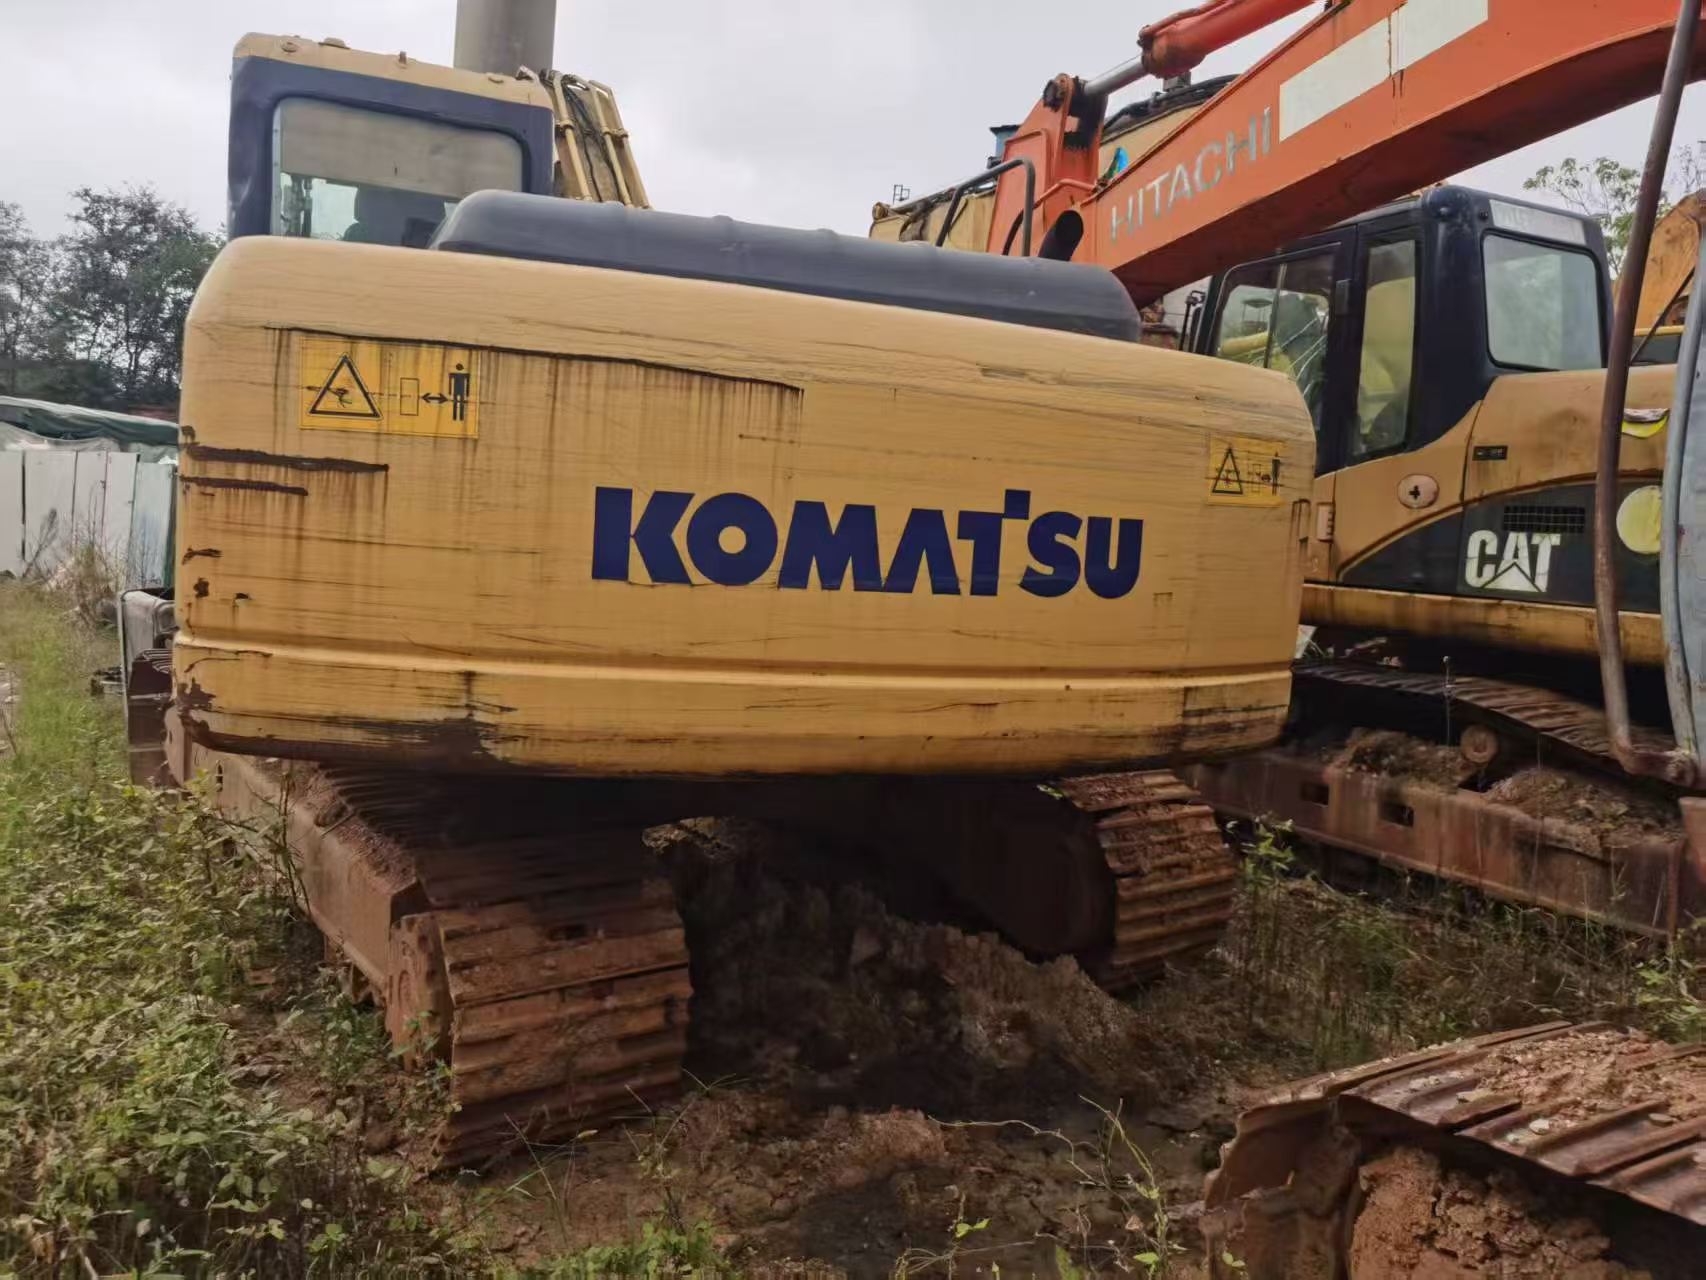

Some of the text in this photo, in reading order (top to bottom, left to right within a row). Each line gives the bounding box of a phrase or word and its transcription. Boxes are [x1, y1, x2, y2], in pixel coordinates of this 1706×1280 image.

[1111, 106, 1272, 241] HITACHI
[592, 486, 1144, 599] KOMATSU
[1465, 530, 1561, 592] CAT
